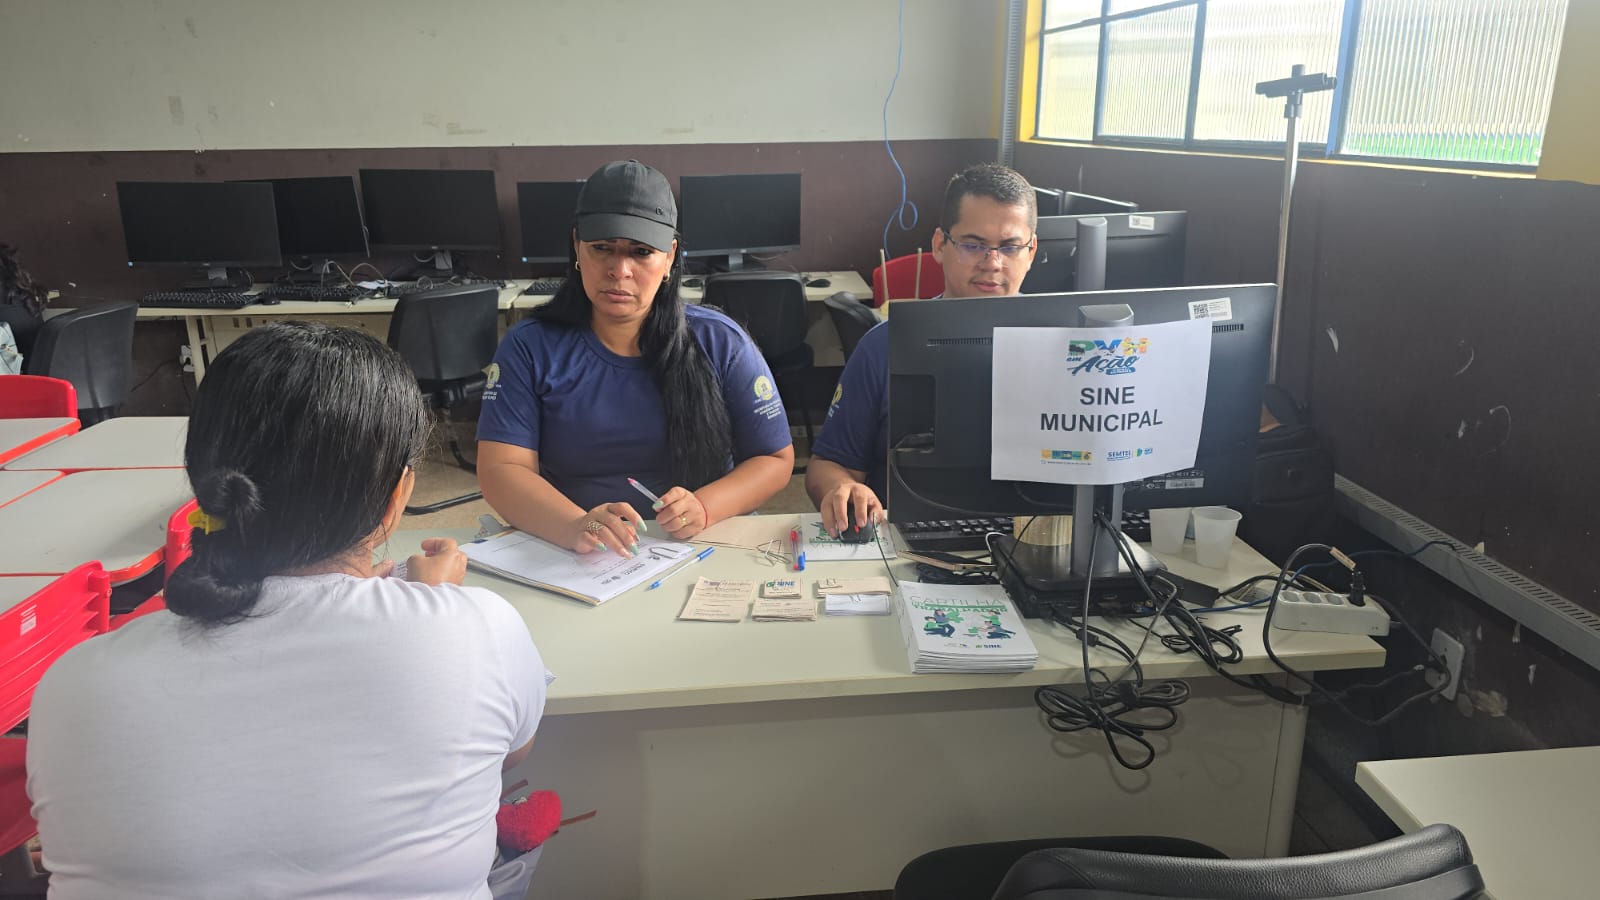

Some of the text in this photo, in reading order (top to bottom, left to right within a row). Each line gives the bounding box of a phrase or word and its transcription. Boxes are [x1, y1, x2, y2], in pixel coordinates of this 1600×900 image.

[1067, 355, 1139, 376] Ação
[1079, 386, 1136, 406] SINE
[1040, 409, 1163, 433] MUNICIPAL
